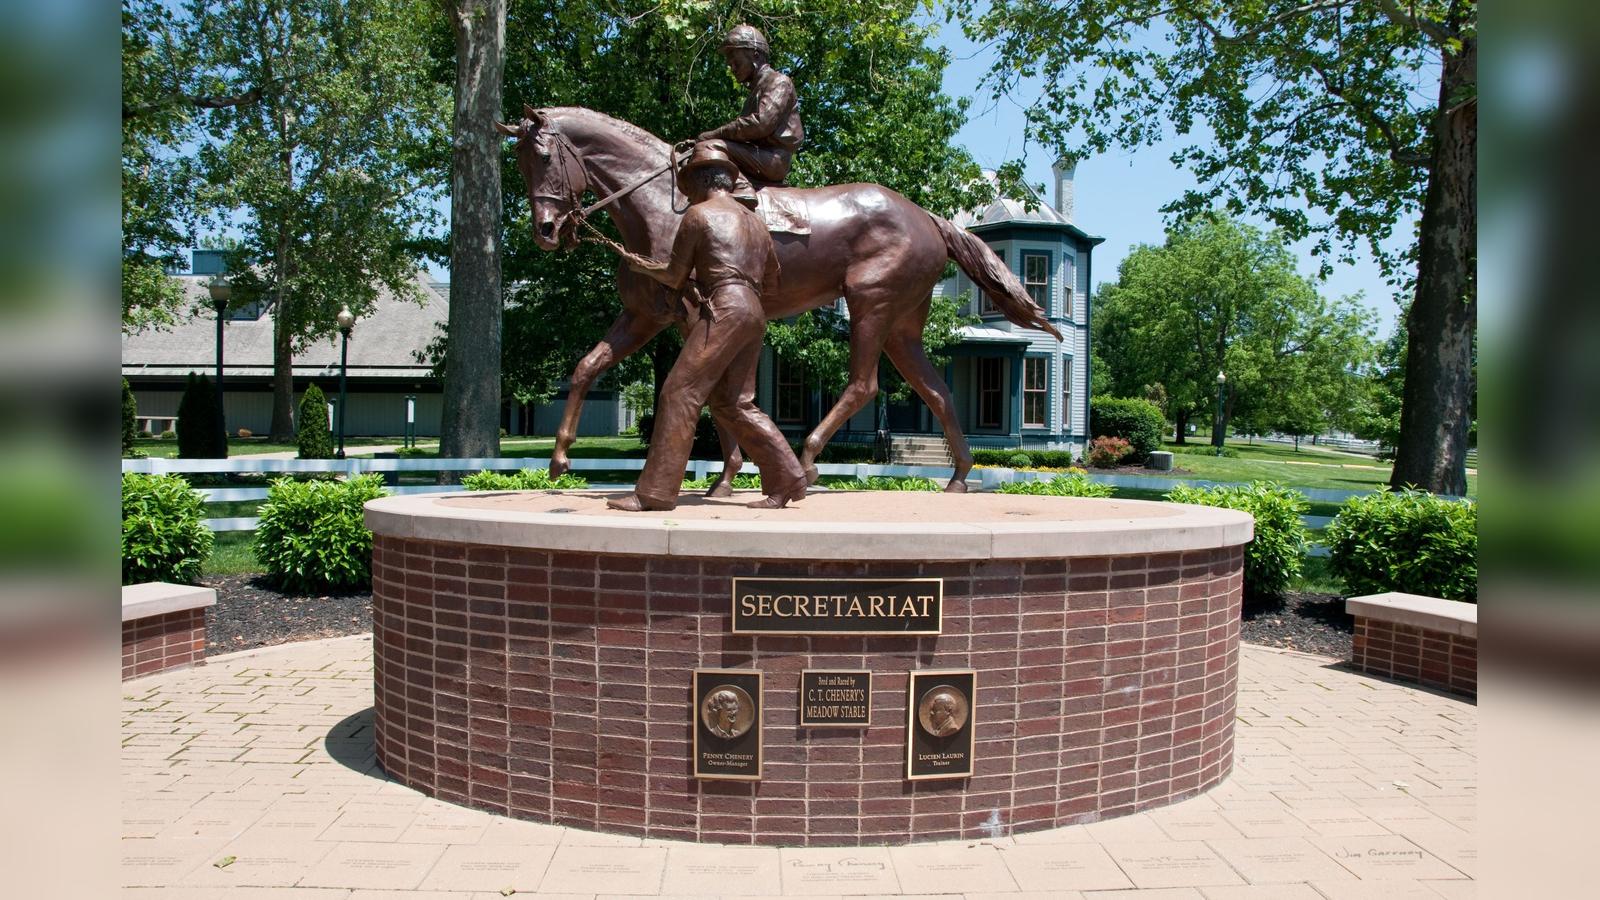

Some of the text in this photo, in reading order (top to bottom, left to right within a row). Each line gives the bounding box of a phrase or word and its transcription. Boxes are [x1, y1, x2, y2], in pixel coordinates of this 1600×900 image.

[741, 594, 934, 617] SECRETARIAT
[829, 677, 837, 686] and
[837, 677, 849, 686] Raced
[850, 677, 856, 687] by
[808, 688, 865, 702] C. T. CHENERY'S
[806, 705, 866, 718] MEADOW STABLE
